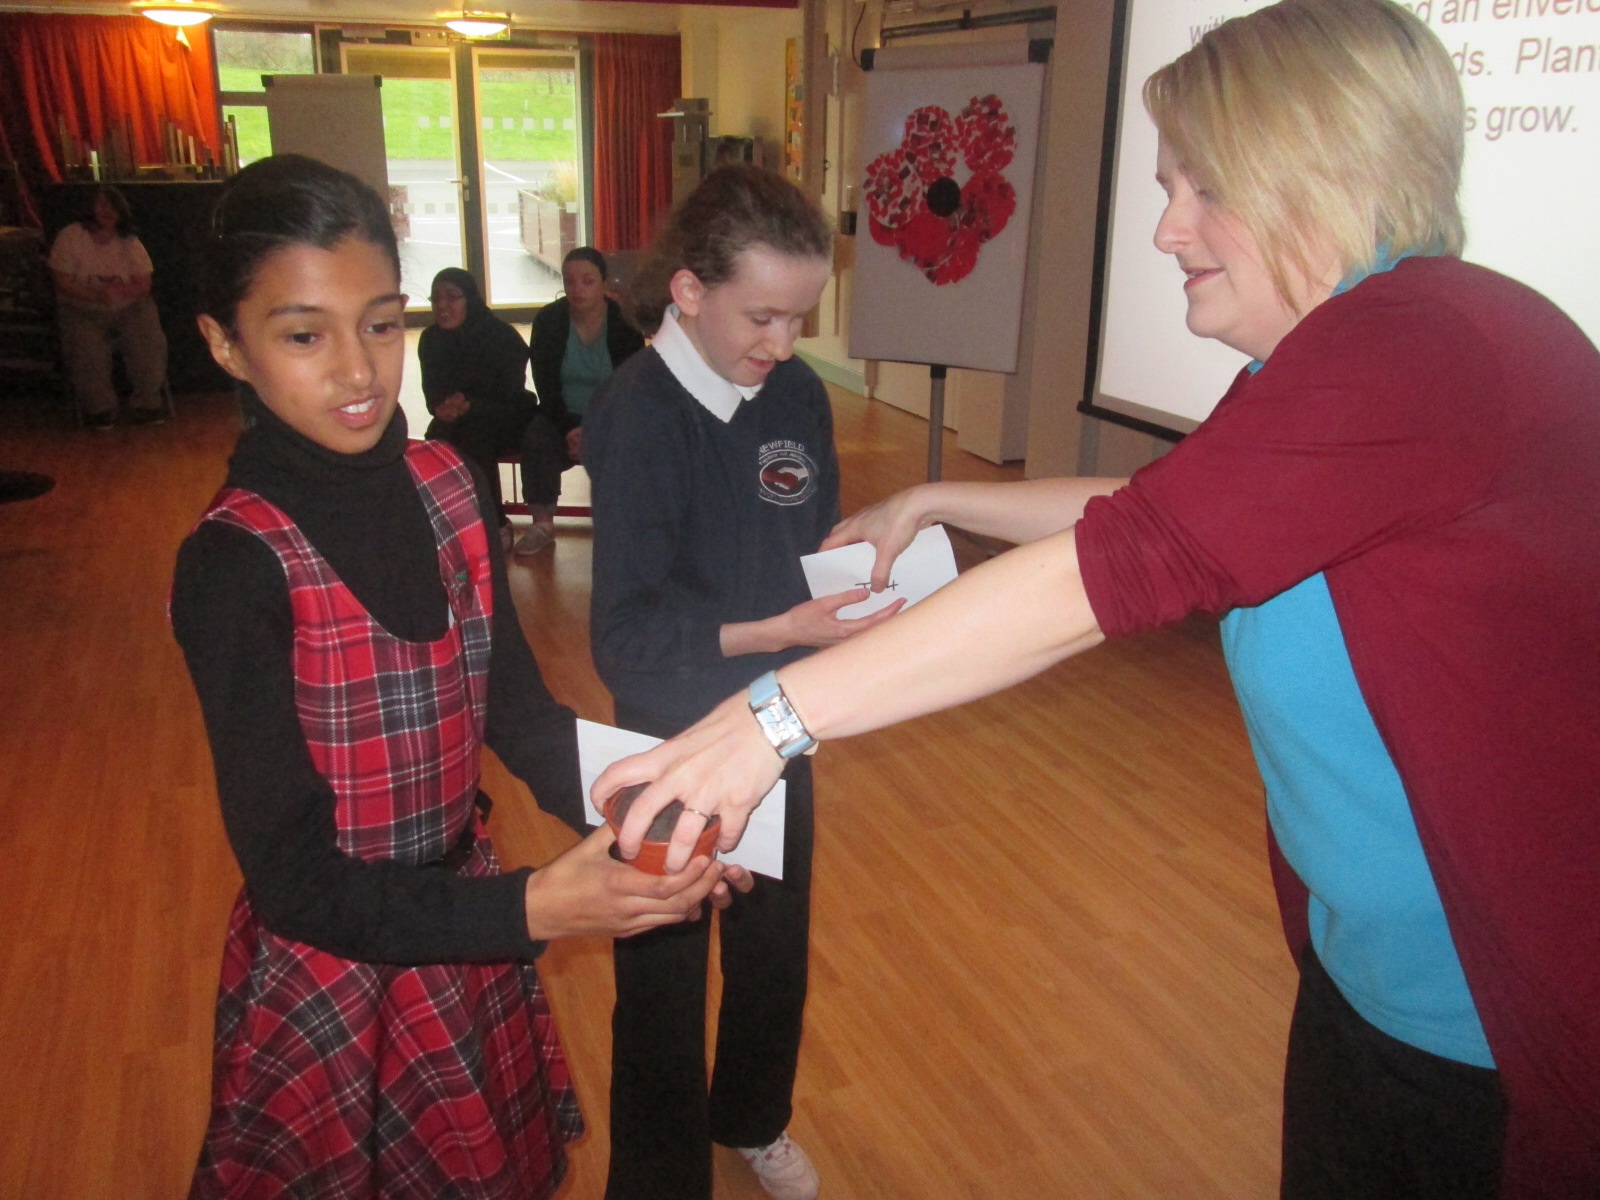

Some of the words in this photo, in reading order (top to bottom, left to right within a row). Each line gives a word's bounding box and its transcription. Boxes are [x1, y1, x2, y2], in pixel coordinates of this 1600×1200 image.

[1441, 0, 1480, 24] an
[1515, 36, 1600, 75] Plan
[1485, 105, 1578, 141] grow.
